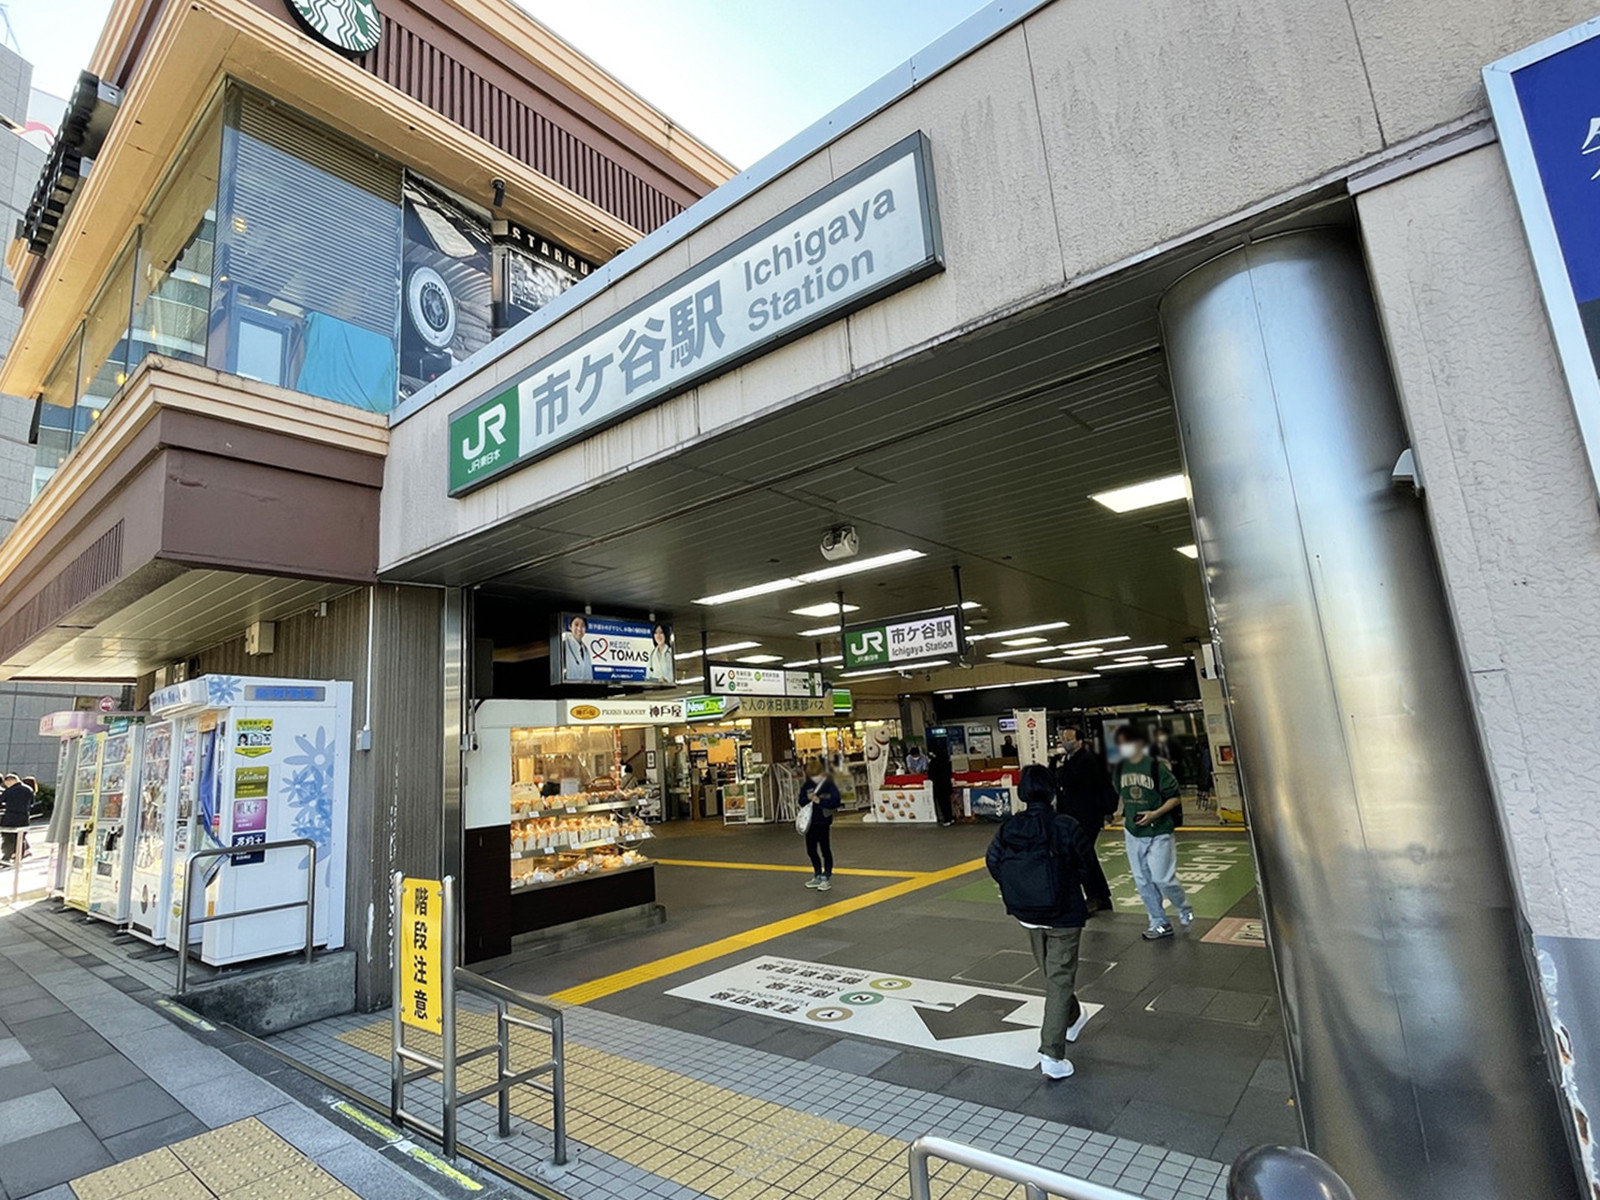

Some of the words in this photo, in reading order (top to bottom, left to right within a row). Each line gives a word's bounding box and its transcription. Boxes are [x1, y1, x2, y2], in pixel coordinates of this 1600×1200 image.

[512, 226, 597, 276] STARBU
[743, 187, 896, 292] Ichigaya
[748, 248, 875, 332] Station
[462, 403, 507, 460] JR
[467, 448, 501, 474] JR東日本
[609, 649, 650, 663] TOMAS
[850, 630, 884, 656] JR
[891, 644, 924, 657] Ichigaya
[925, 640, 954, 653] Station
[649, 704, 683, 718] 神戸屋
[687, 697, 726, 713] NewDays
[413, 886, 429, 1020] 階段注意
[709, 991, 800, 1015] 有楽町線
[765, 982, 835, 999] 南北線
